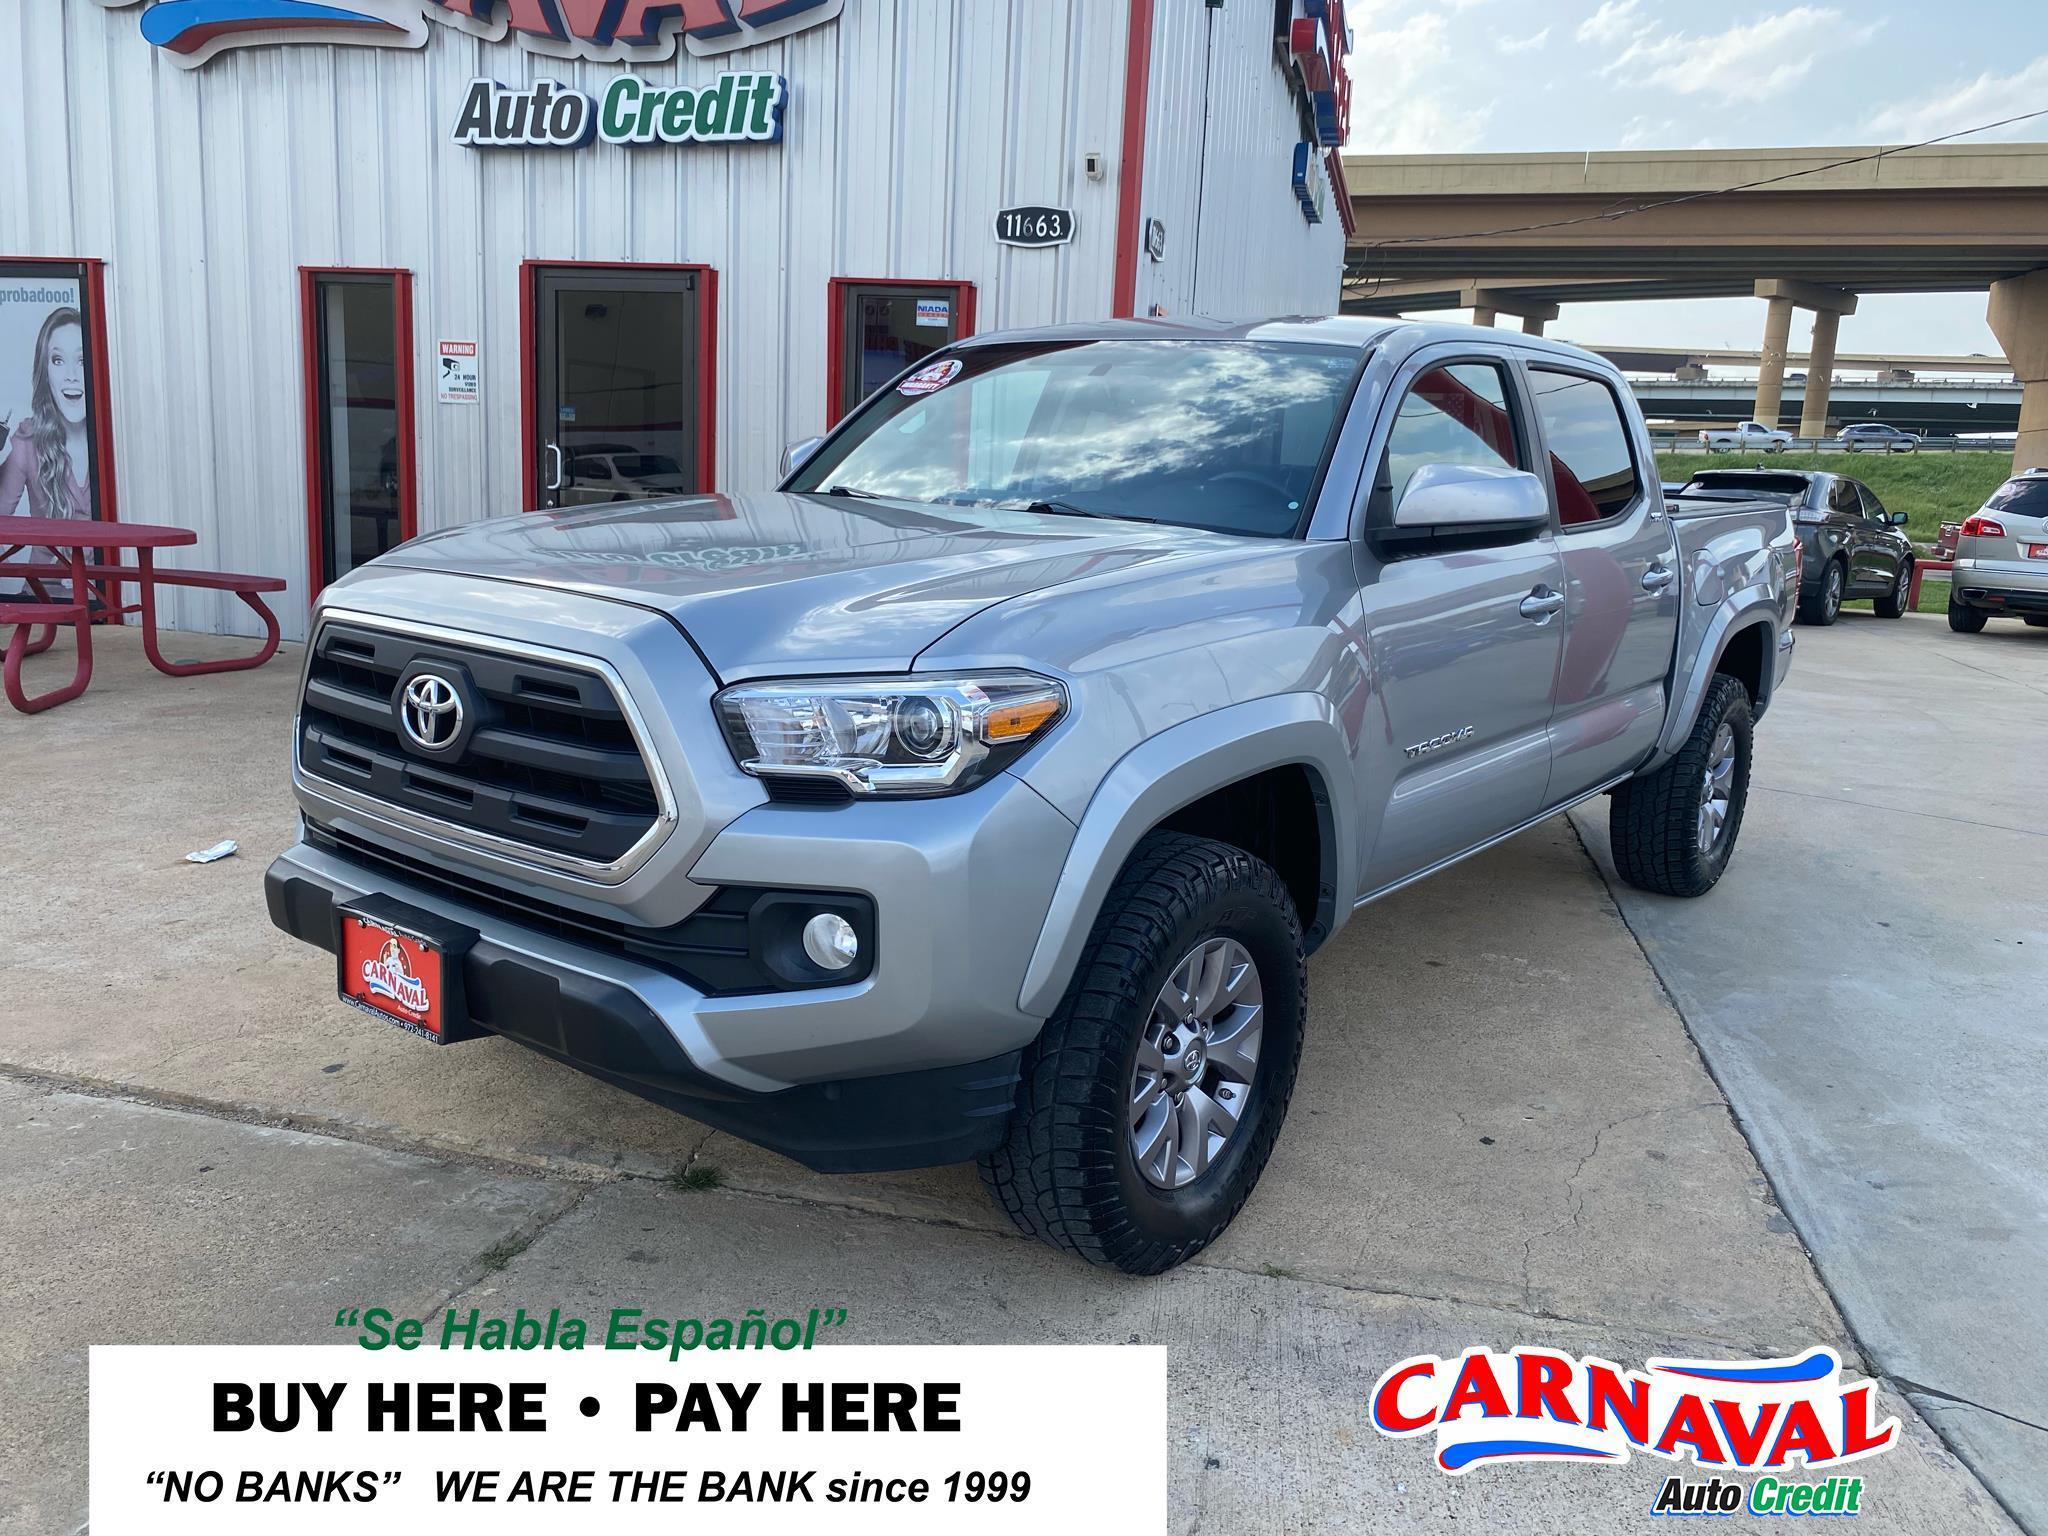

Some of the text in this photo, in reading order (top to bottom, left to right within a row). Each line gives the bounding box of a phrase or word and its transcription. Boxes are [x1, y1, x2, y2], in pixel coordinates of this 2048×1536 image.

[455, 75, 775, 139] Auto Credit
[1006, 214, 1061, 237] 11663
[0, 287, 74, 305] probadooo!
[442, 343, 474, 354] WARNING
[1404, 725, 1474, 757] TACOMA
[362, 961, 430, 1008] CARNAVAL
[403, 1021, 439, 1043] 972-241-8141
